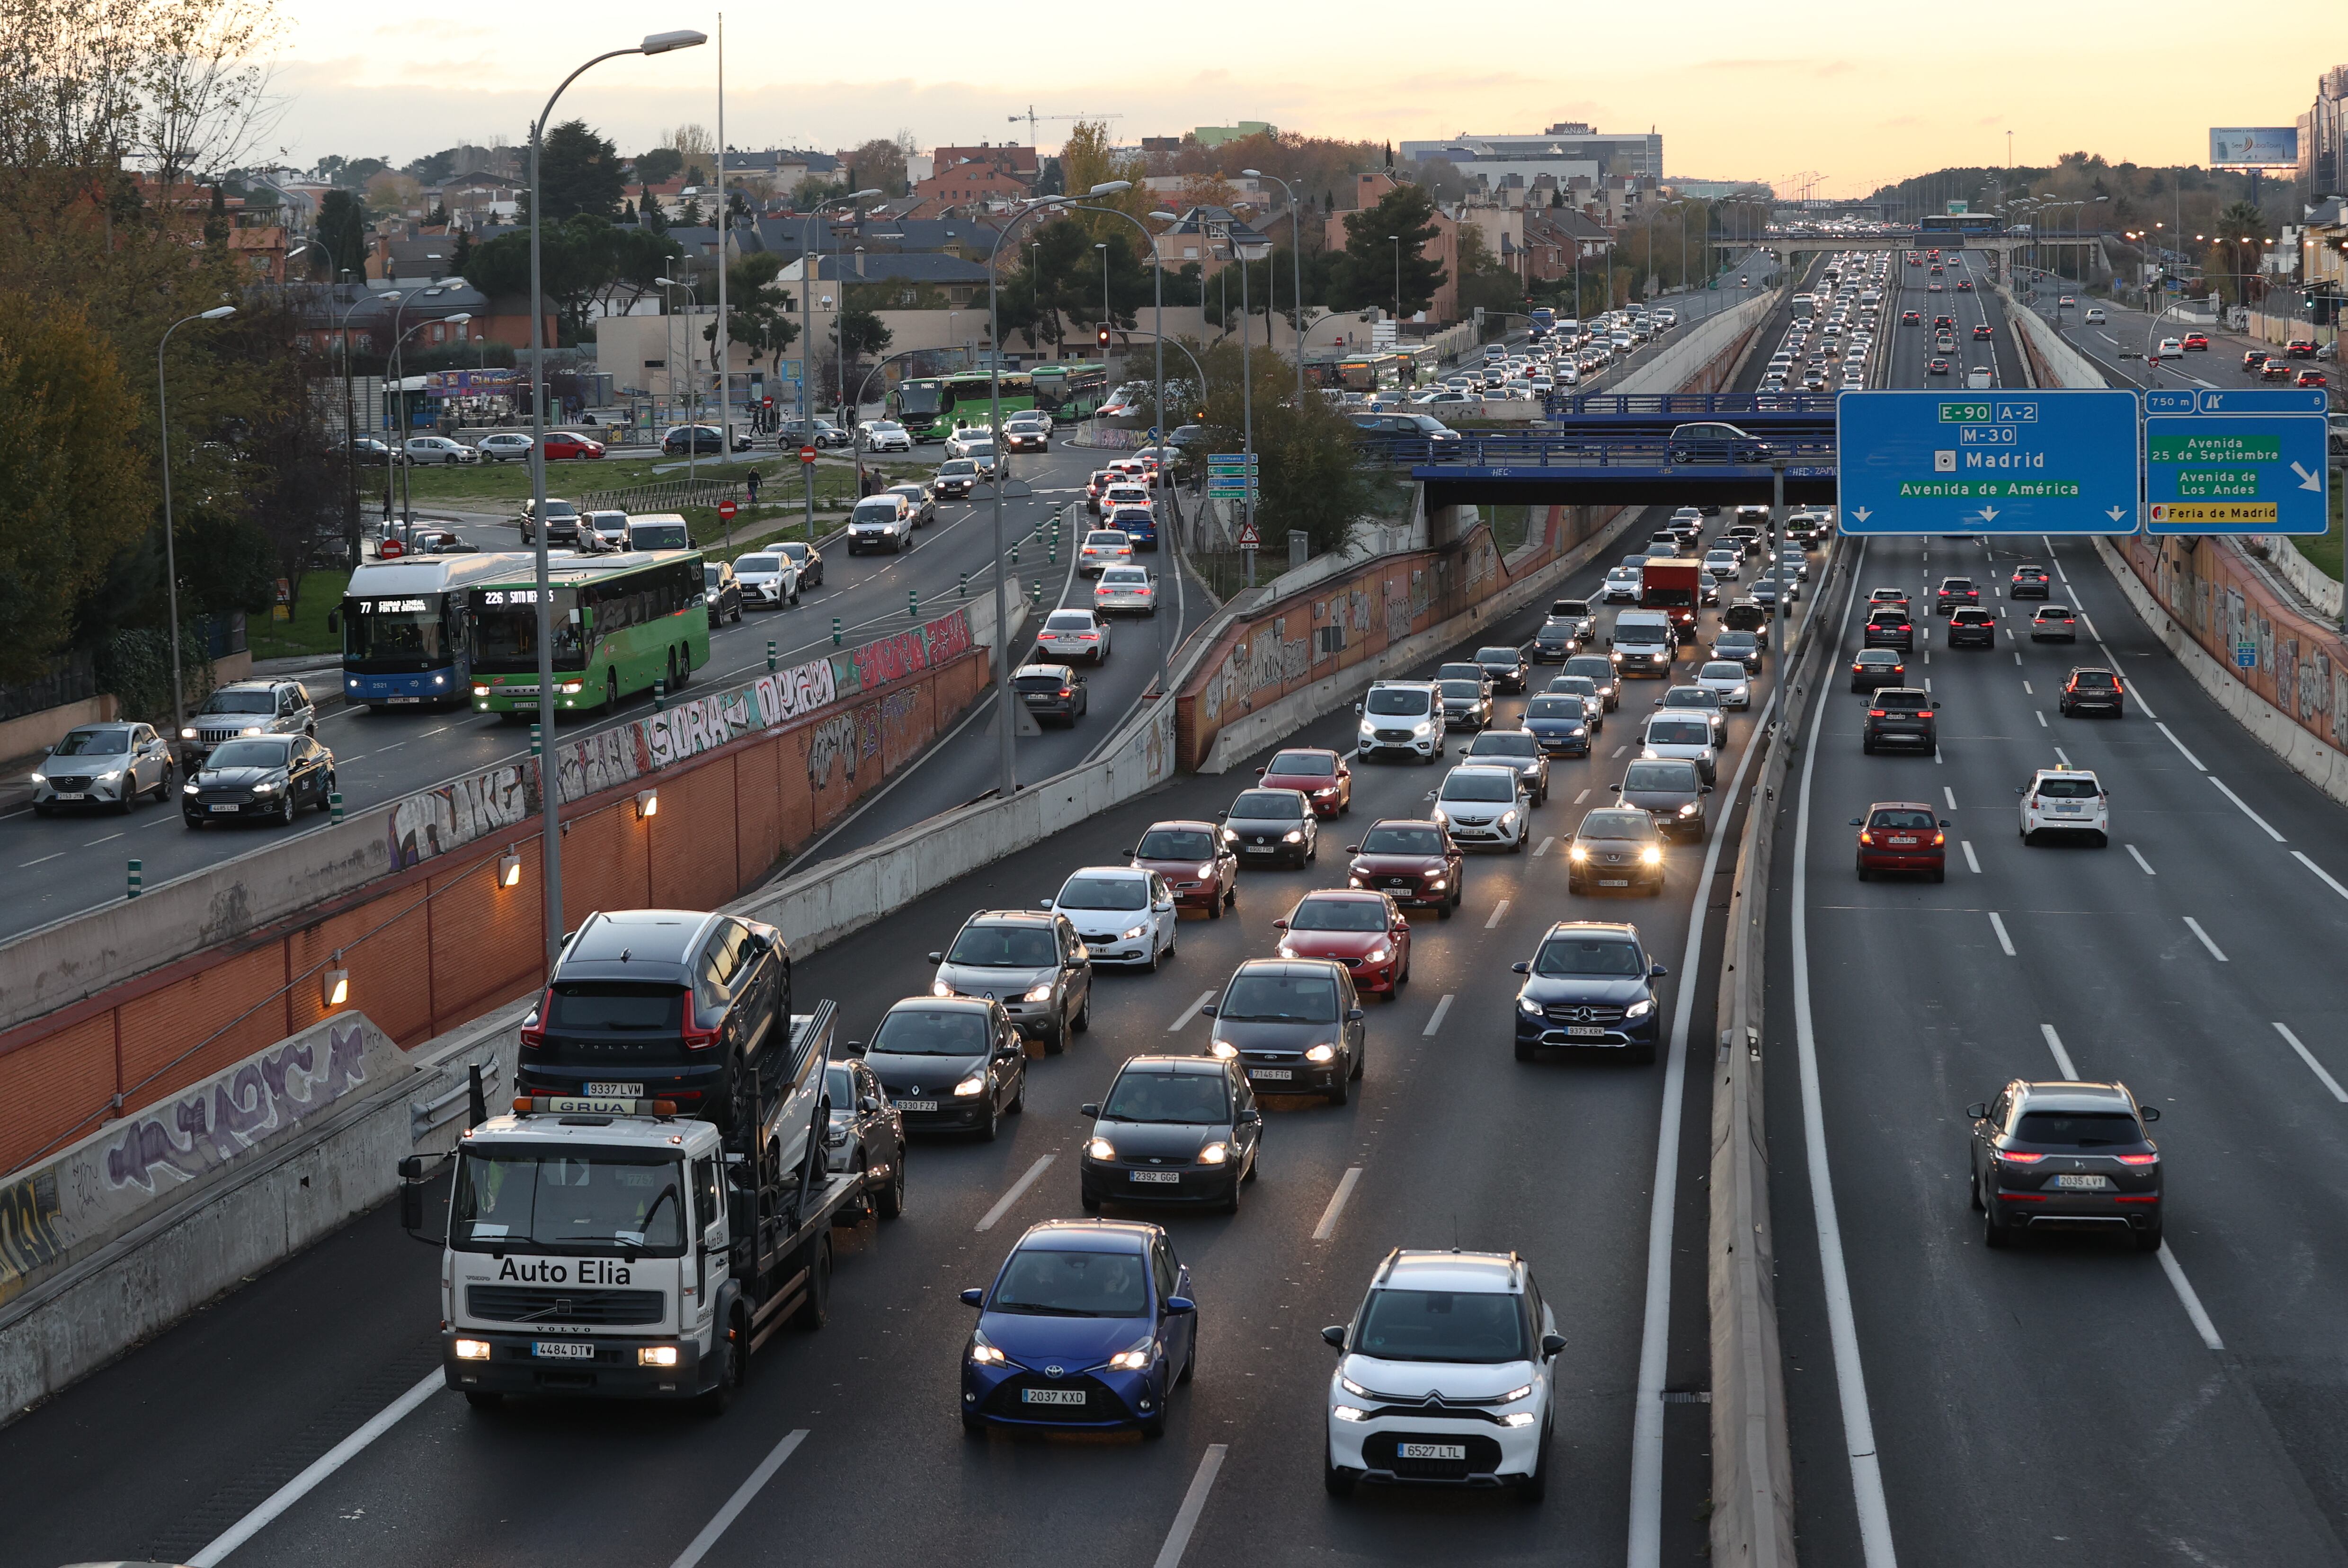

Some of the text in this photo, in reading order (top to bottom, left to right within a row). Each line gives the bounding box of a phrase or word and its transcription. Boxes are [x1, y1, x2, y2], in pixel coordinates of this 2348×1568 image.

[1564, 126, 1592, 134] ANAYA
[2152, 398, 2174, 406] 750
[2313, 397, 2321, 405] 8
[1943, 406, 1988, 419] E-90
[2001, 407, 2034, 419] A-2
[1964, 429, 2013, 442] M-30
[2188, 438, 2243, 448] Avenida
[1966, 453, 2044, 468] Madrid
[2152, 450, 2278, 462] 25 de Septiembre
[2179, 472, 2256, 481] Avenida de
[1900, 482, 2079, 496] Avenida de América
[2182, 484, 2255, 494] Los Andes
[2169, 508, 2276, 518] Feria de Madrid
[485, 592, 503, 604] 226
[510, 591, 526, 603] SOTO
[360, 602, 372, 614] 77
[1254, 1069, 1273, 1078] 7146
[591, 1084, 640, 1095] 9337 LVM
[560, 1102, 625, 1113] GRUA
[898, 1101, 935, 1110] 6330 FZZ
[1135, 1172, 1178, 1182] 2392 GGG
[2060, 1176, 2103, 1186] 2035 LVY
[707, 1235, 716, 1249] Auto
[498, 1257, 631, 1284] Auto Elia
[540, 1344, 592, 1356] 4484 DTW
[1030, 1391, 1083, 1403] 2037 KXD
[1407, 1445, 1460, 1458] 6527 LTL
